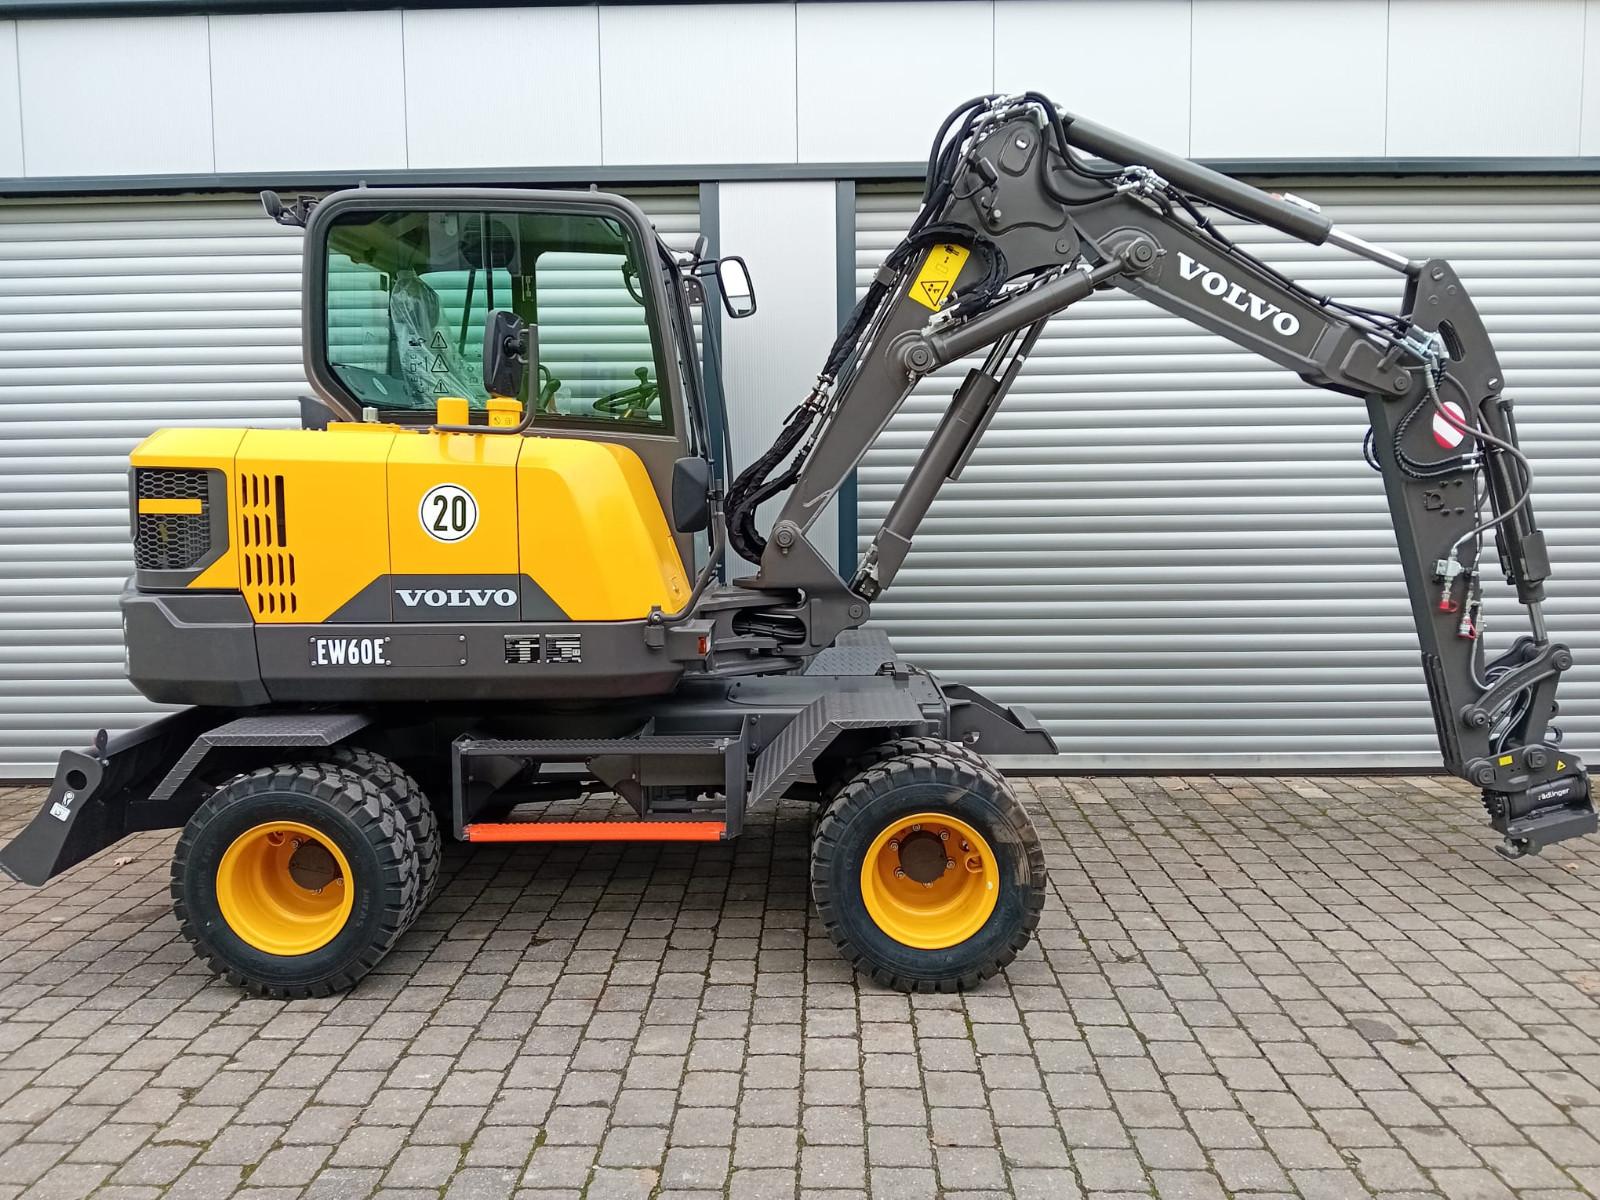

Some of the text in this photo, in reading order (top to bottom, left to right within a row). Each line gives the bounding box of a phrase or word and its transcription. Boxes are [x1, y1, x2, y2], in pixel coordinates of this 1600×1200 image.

[1177, 252, 1300, 336] VOLVO
[433, 495, 467, 531] 20
[395, 589, 518, 607] VOLVO
[317, 638, 385, 664] EW60E
